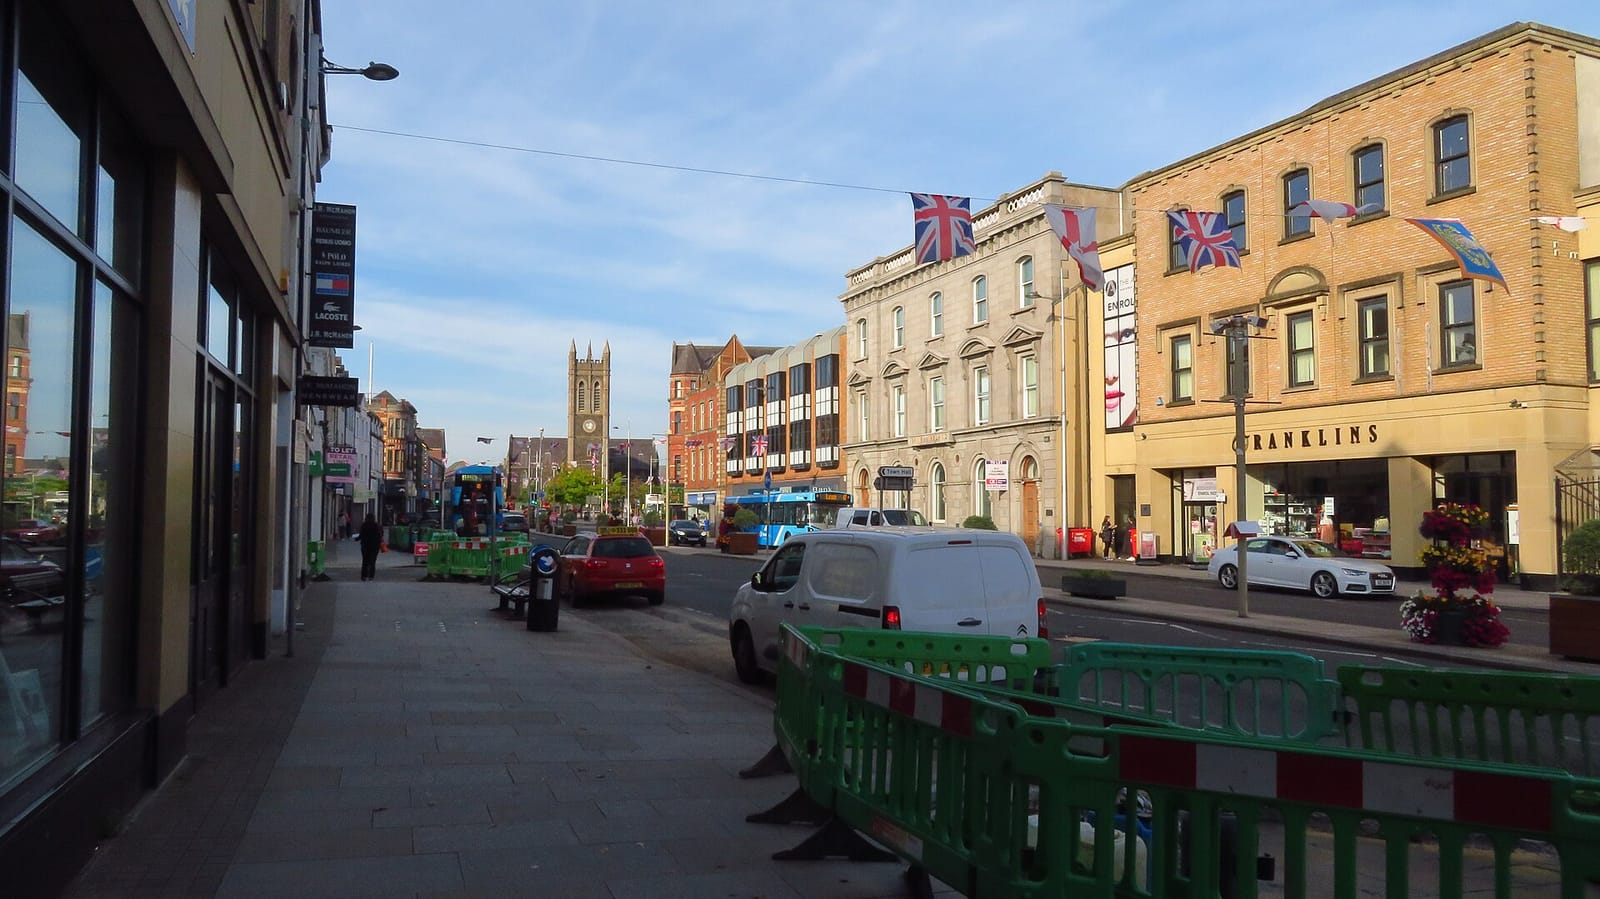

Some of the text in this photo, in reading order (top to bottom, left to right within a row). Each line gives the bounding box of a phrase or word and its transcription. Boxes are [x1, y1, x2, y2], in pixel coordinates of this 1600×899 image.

[327, 252, 347, 260] POLO
[1107, 297, 1134, 311] ENROL
[315, 312, 349, 321] LACOSTE
[886, 467, 912, 476] Town Hall
